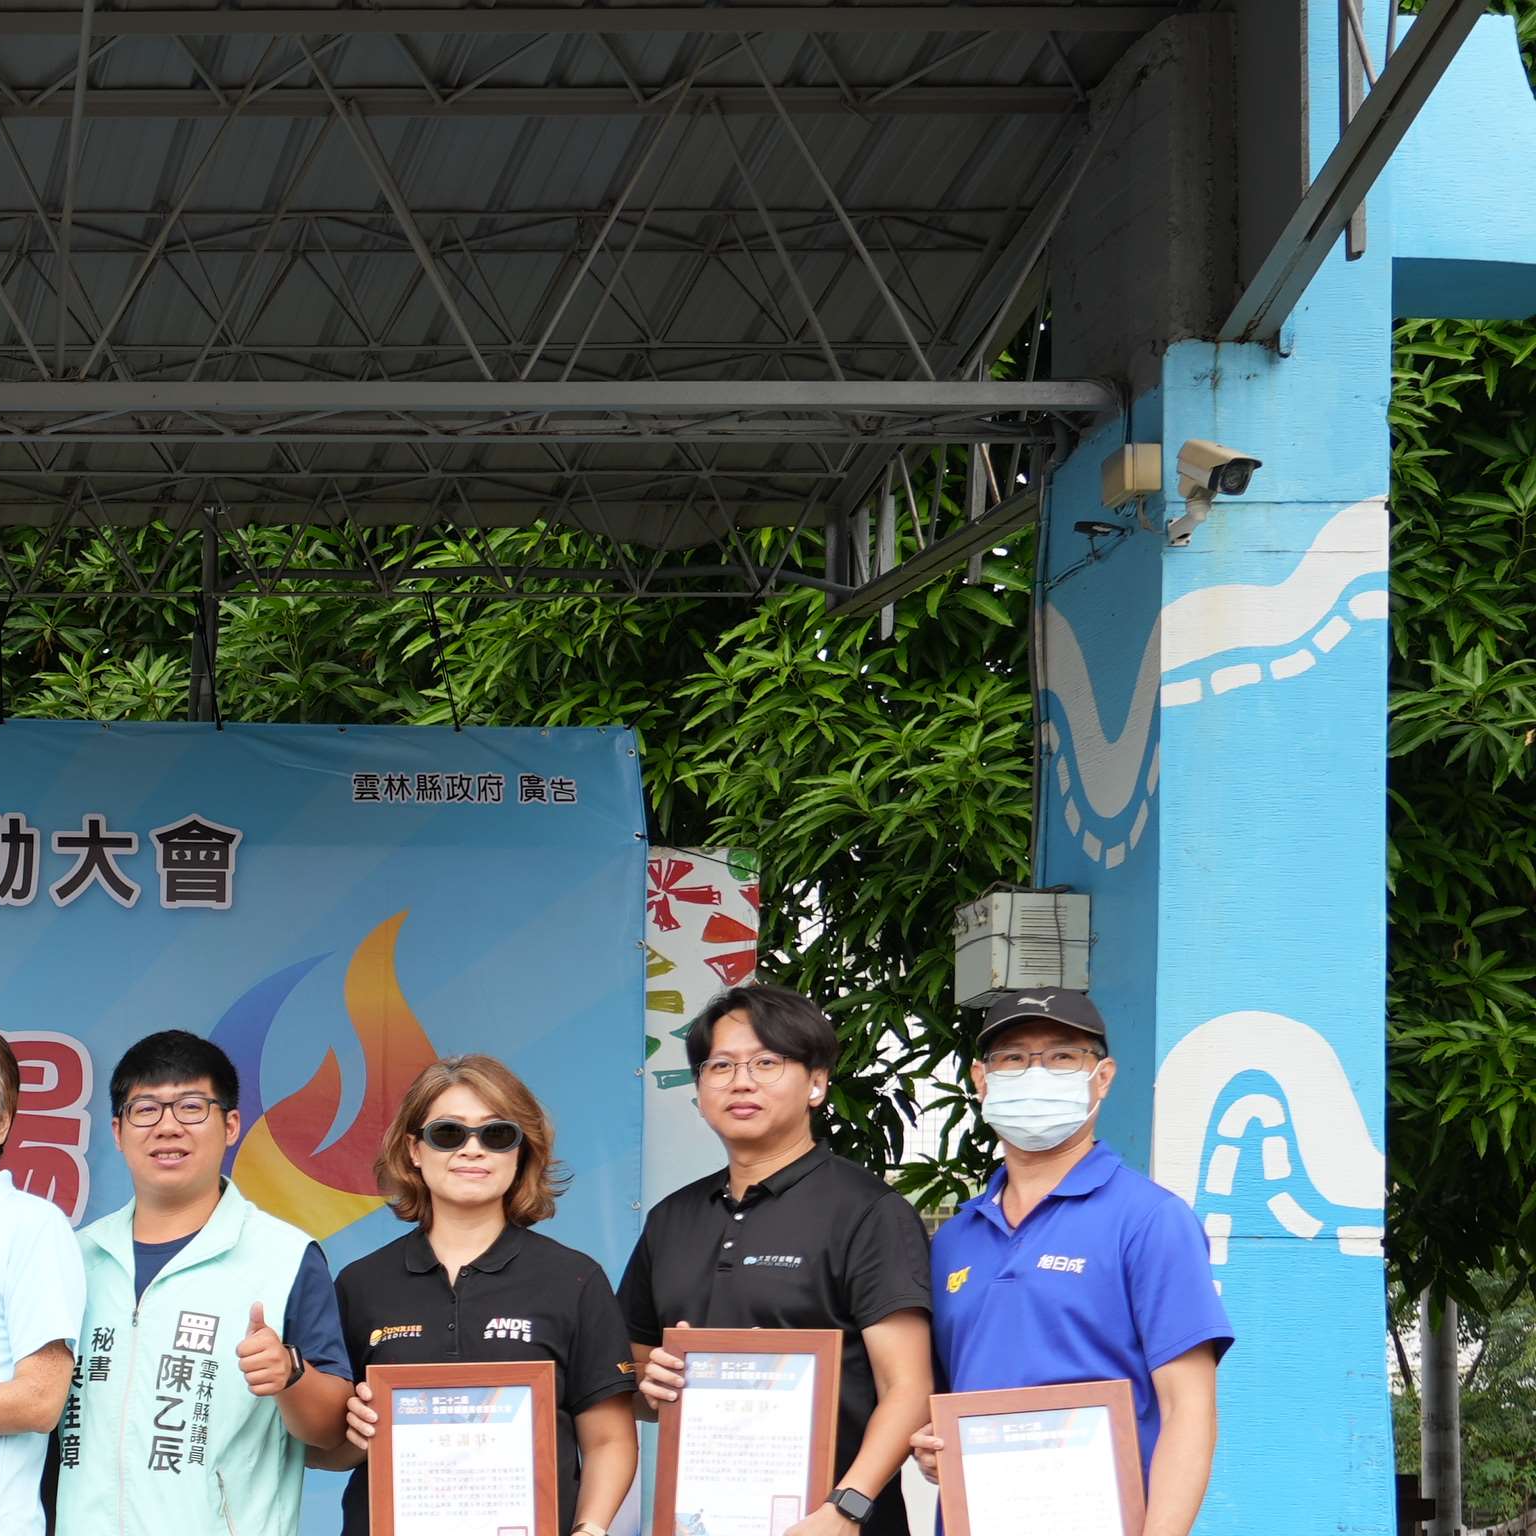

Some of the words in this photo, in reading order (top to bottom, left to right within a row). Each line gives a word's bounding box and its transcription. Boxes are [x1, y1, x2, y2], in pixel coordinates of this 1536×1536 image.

[353, 773, 504, 803] 雲林縣政府
[519, 773, 578, 803] 廣告
[485, 1318, 532, 1333] ANDE
[88, 1327, 115, 1382] 秘書
[148, 1354, 195, 1474] 陳乙辰
[188, 1359, 219, 1466] 雲林縣議員
